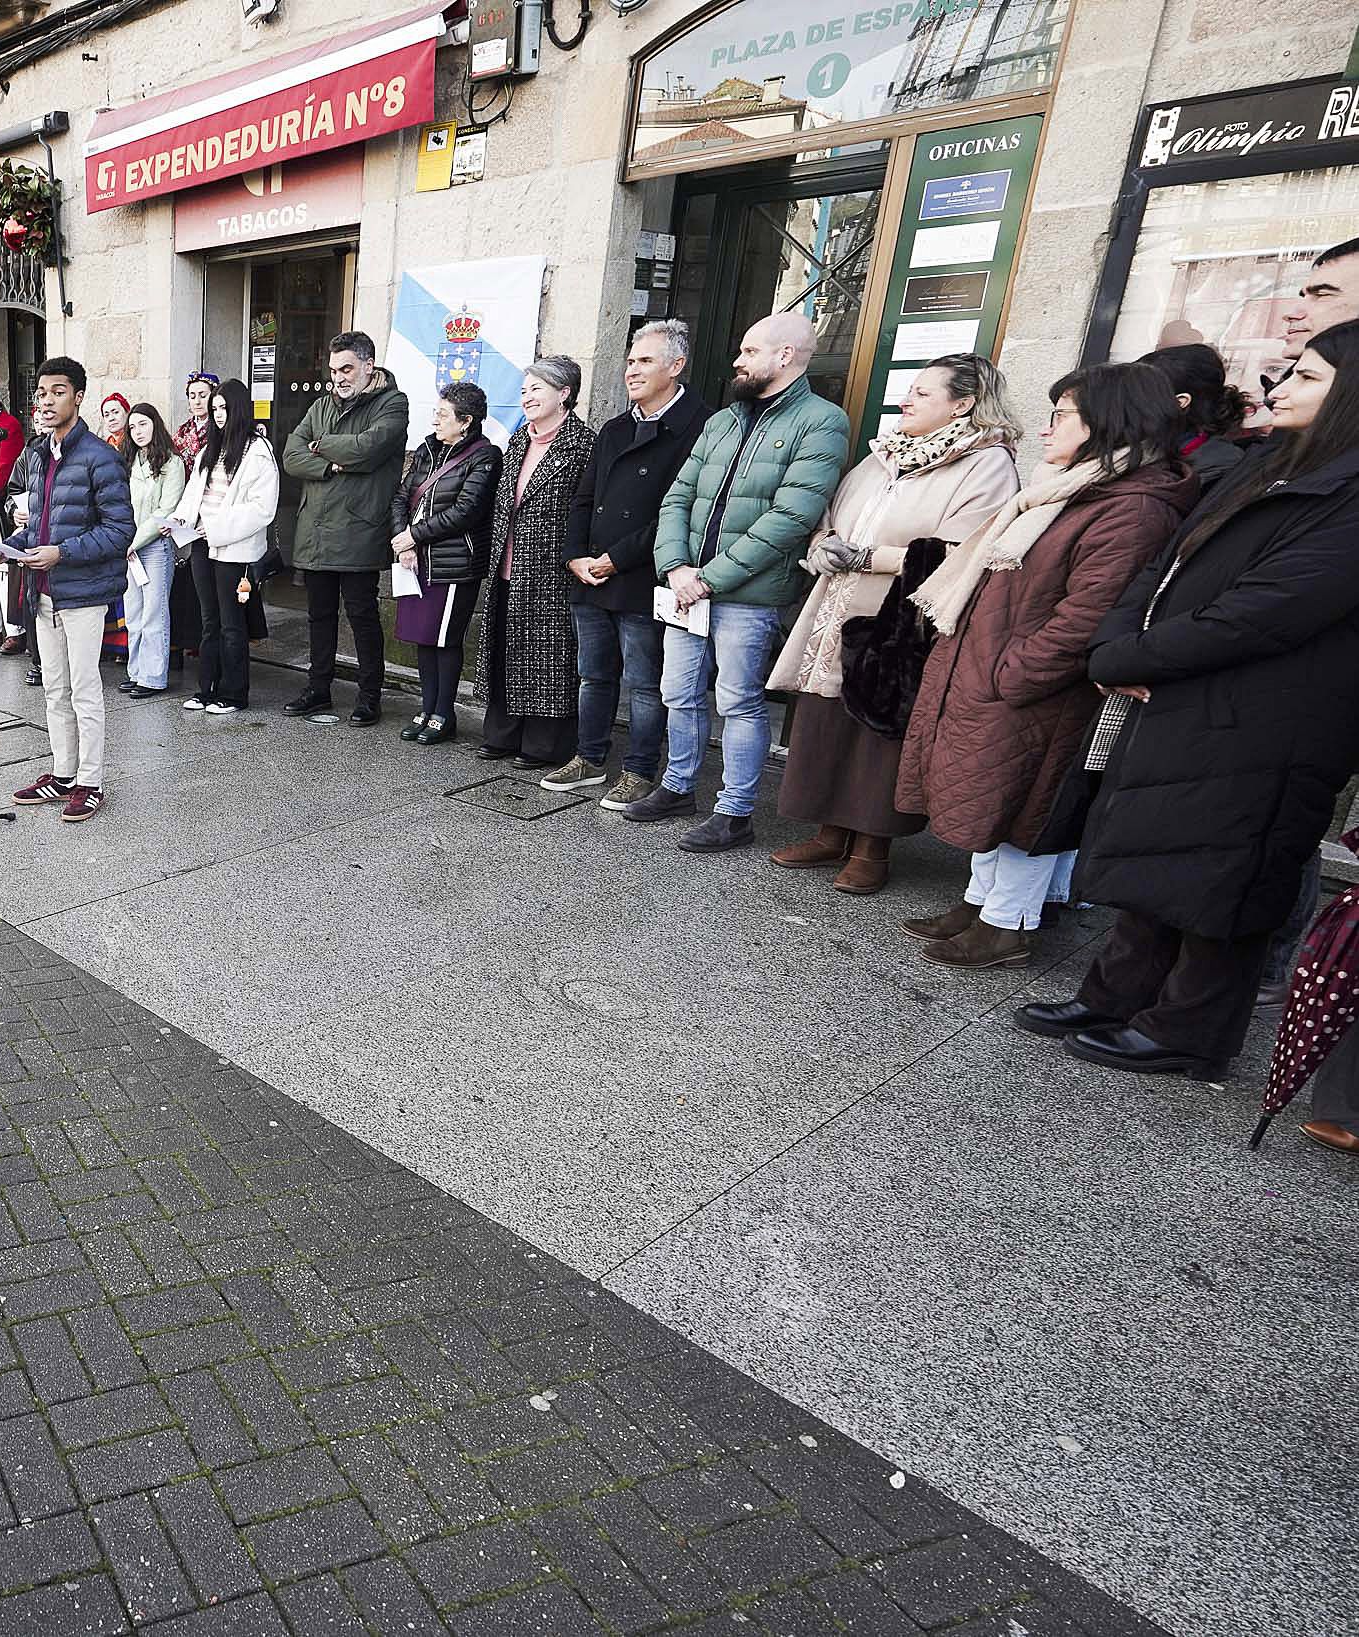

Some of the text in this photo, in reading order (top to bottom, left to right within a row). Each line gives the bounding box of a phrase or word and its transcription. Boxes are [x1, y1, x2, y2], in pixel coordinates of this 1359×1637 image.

[710, 30, 797, 68] PLAZA
[805, 17, 845, 46] DE
[817, 60, 835, 90] 1
[126, 93, 335, 193] EXPENDEDURÍA
[344, 75, 406, 130] Nº8
[1172, 120, 1306, 156] Olimpio
[1224, 121, 1249, 133] FOTO
[929, 132, 1022, 161] OFICINAS
[217, 203, 308, 239] TABACOS
